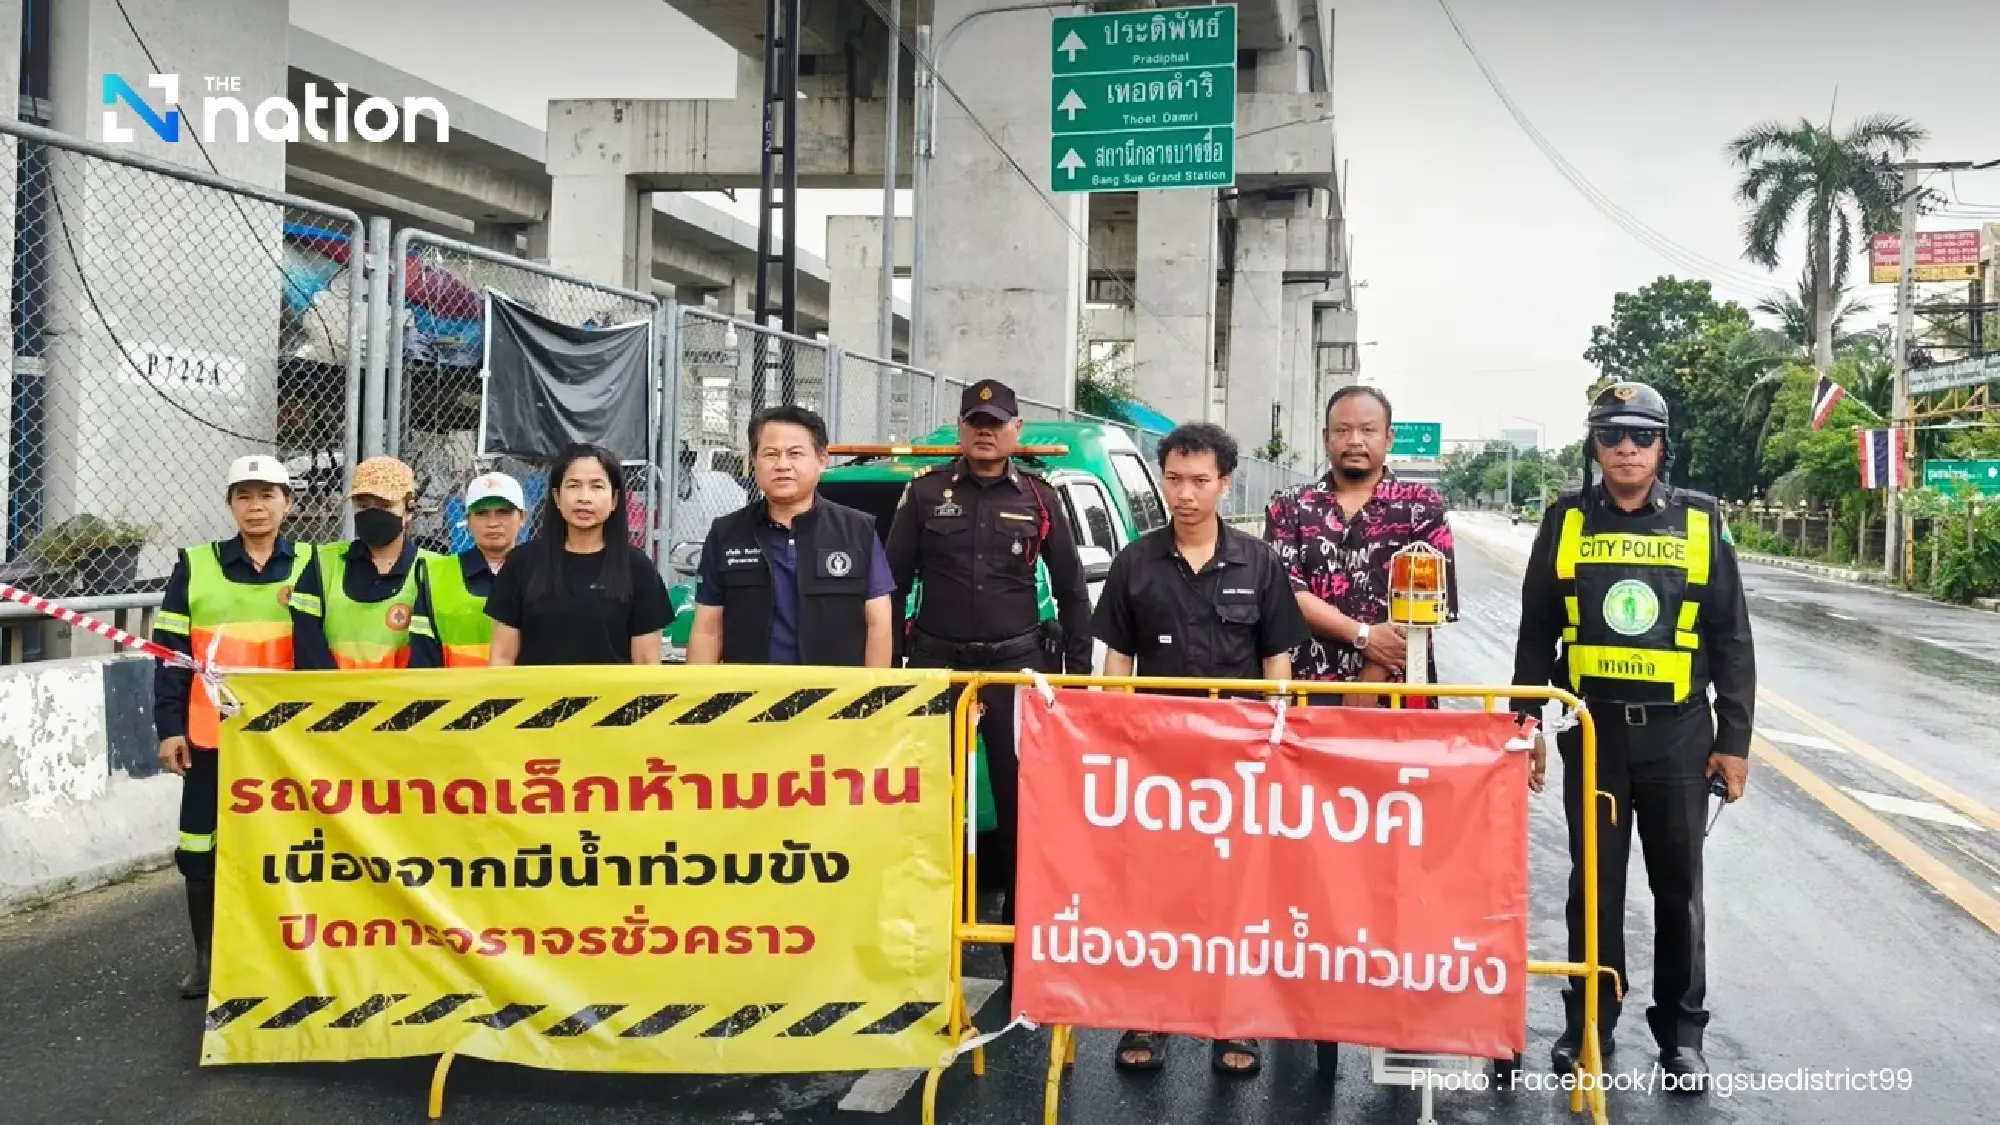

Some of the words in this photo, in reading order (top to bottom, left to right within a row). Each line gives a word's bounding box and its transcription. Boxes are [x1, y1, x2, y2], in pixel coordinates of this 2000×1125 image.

[1104, 11, 1225, 46] ประดิพัทธ์
[1133, 52, 1190, 65] Pradiphat
[1107, 71, 1213, 103] เทอดดำริ
[1122, 114, 1156, 124] Thoet
[1163, 111, 1198, 123] Damri
[1095, 128, 1223, 167] สถานีกลางบางซื่อ
[1091, 174, 1119, 186] Bang
[1124, 173, 1144, 184] Sue
[1147, 171, 1181, 183] Grand
[1184, 169, 1226, 181] Station
[1580, 540, 1616, 558] CITY
[1621, 540, 1685, 561] POLICE
[229, 754, 922, 816] รถขนาดเล็กห้ามผ่าน
[1081, 754, 1430, 860] ปิดอุโมงค์
[262, 827, 850, 888] เนื่องจากมีน้ำท่วมขัง
[278, 905, 816, 957] ปิดการจราจรชั่วคราว
[1031, 893, 1508, 996] เนื่องจากมีน้ำท่วมขัง
